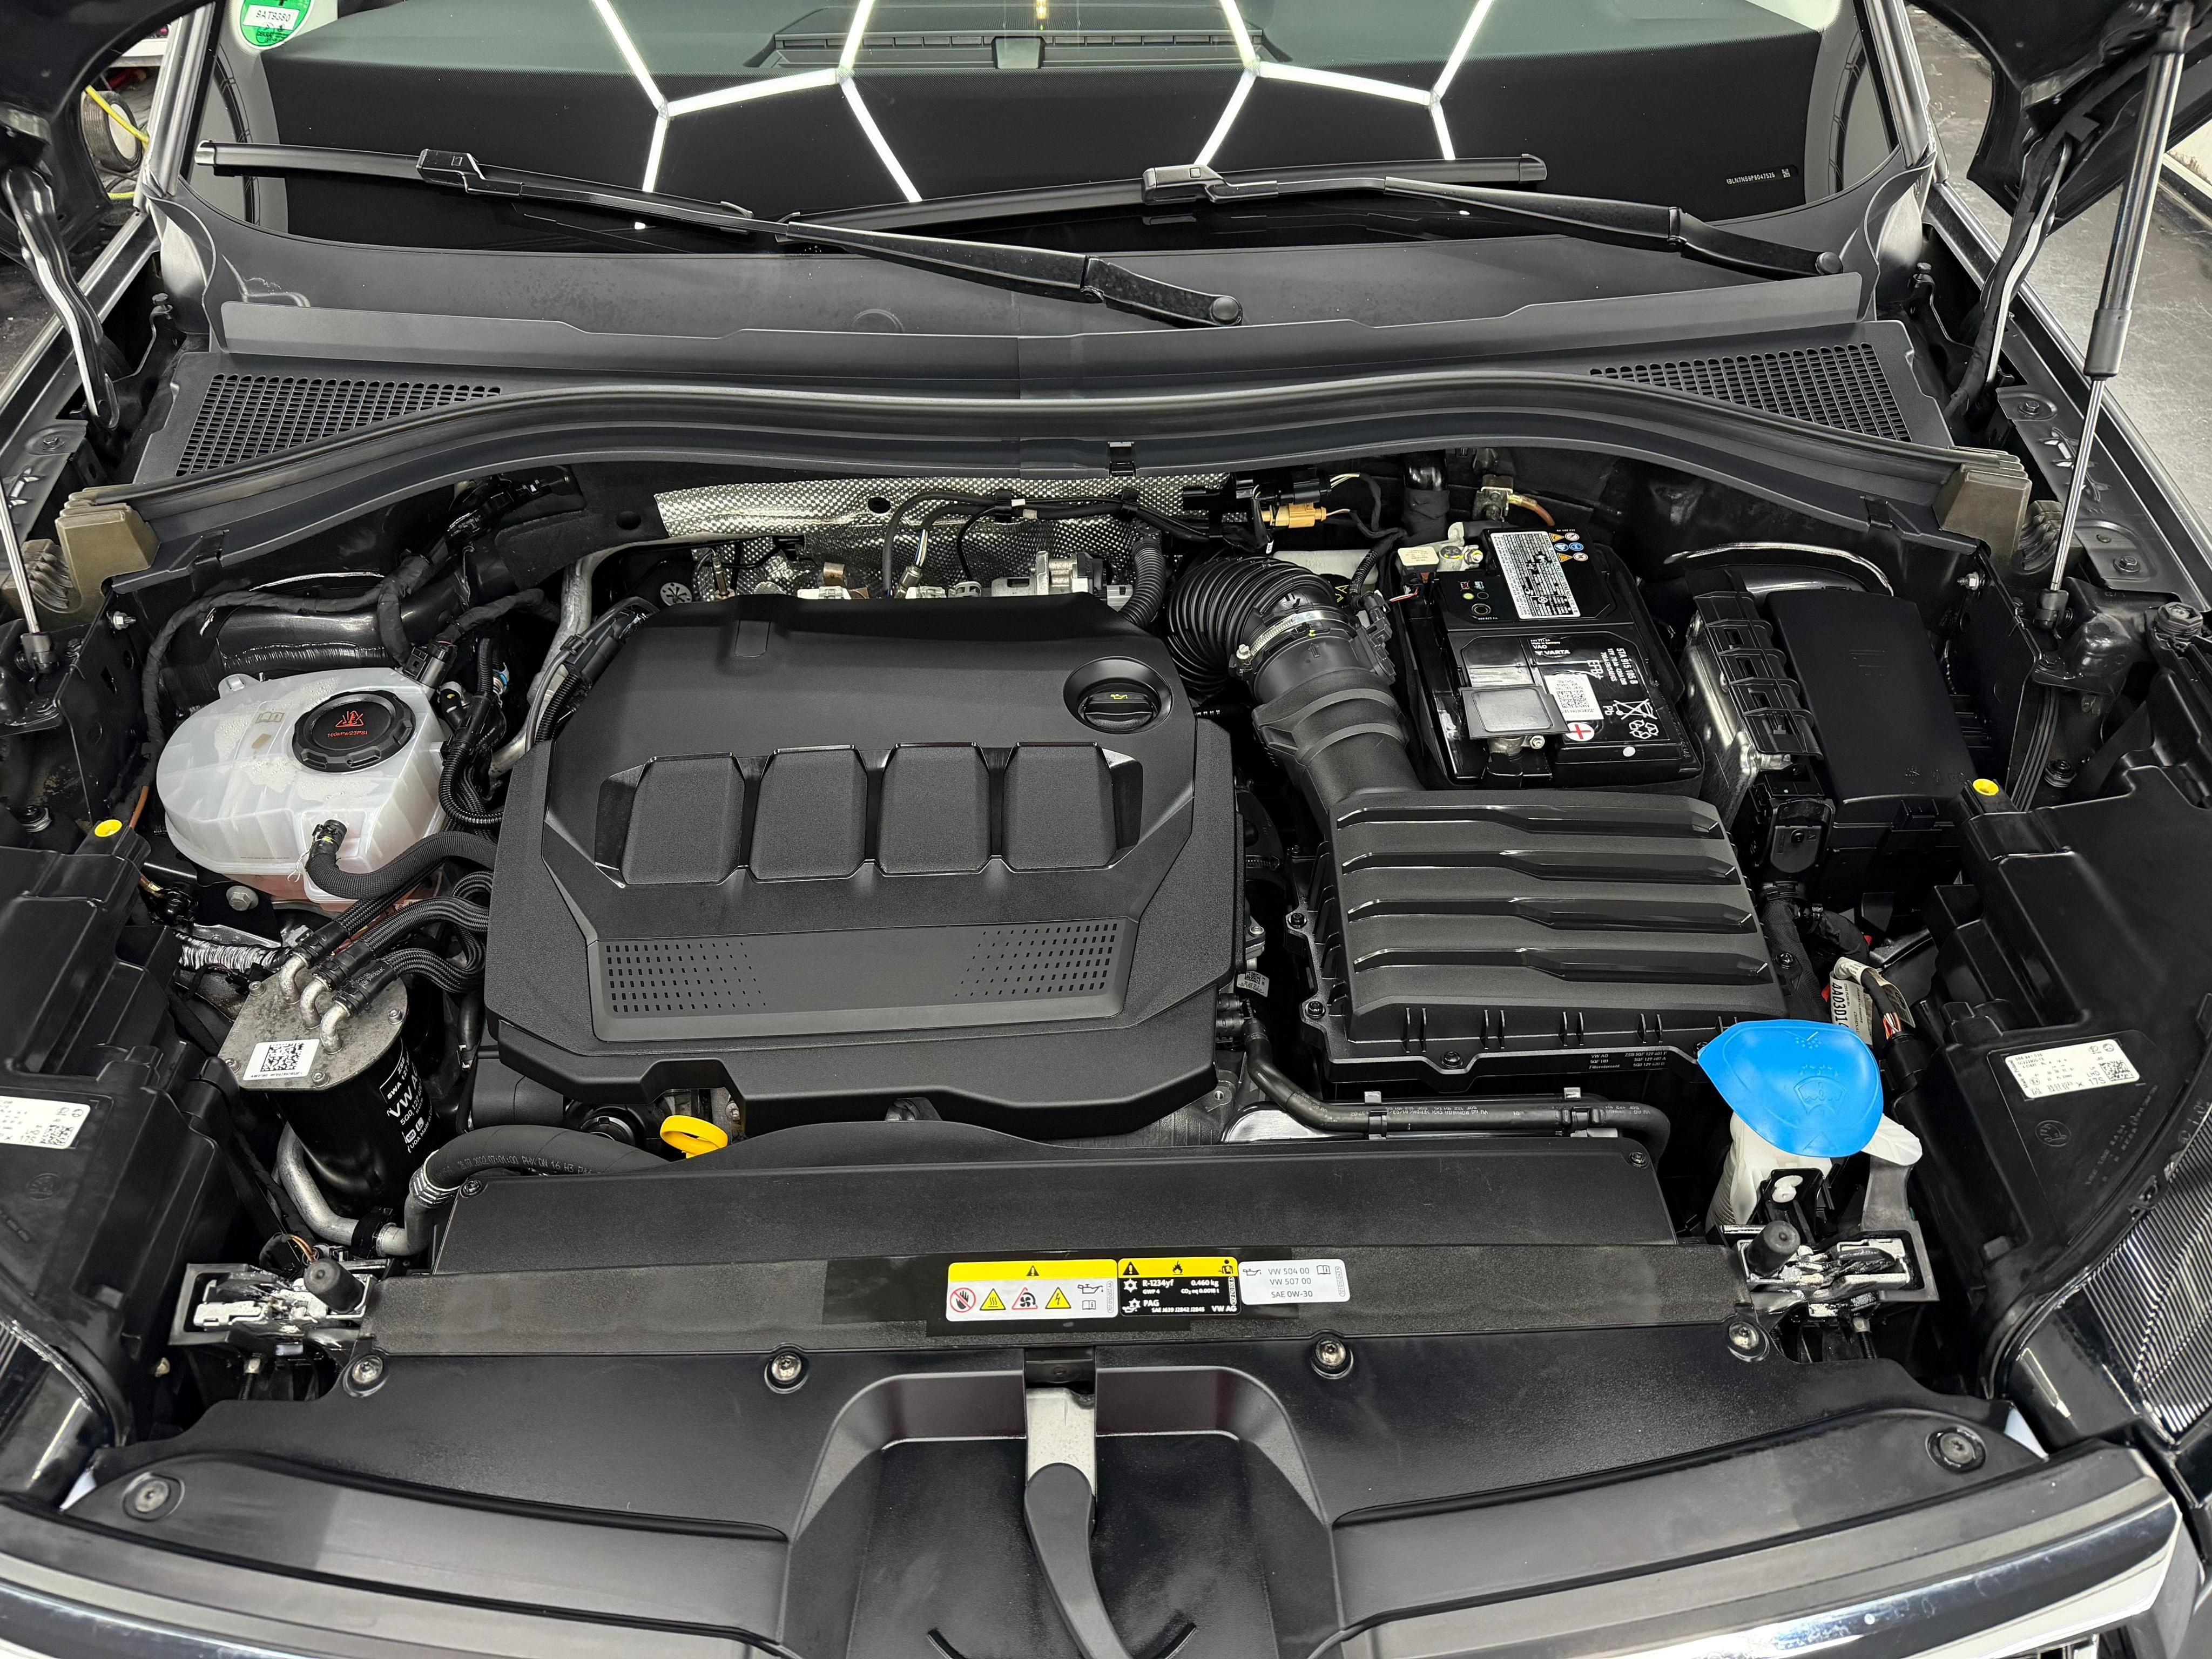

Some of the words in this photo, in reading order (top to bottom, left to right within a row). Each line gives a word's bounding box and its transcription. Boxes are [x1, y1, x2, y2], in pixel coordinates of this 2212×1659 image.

[1616, 648, 1627, 658] 5TA
[1621, 658, 1631, 669] 915
[1587, 660, 1604, 680] EFB+
[1626, 669, 1636, 679] 105
[1602, 706, 1614, 716] Pb
[387, 1082, 402, 1100] 5WA
[389, 1085, 413, 1117] VW
[551, 1161, 561, 1170] 16
[1142, 1279, 1174, 1288] R-1234yf
[1210, 1279, 1219, 1287] kg
